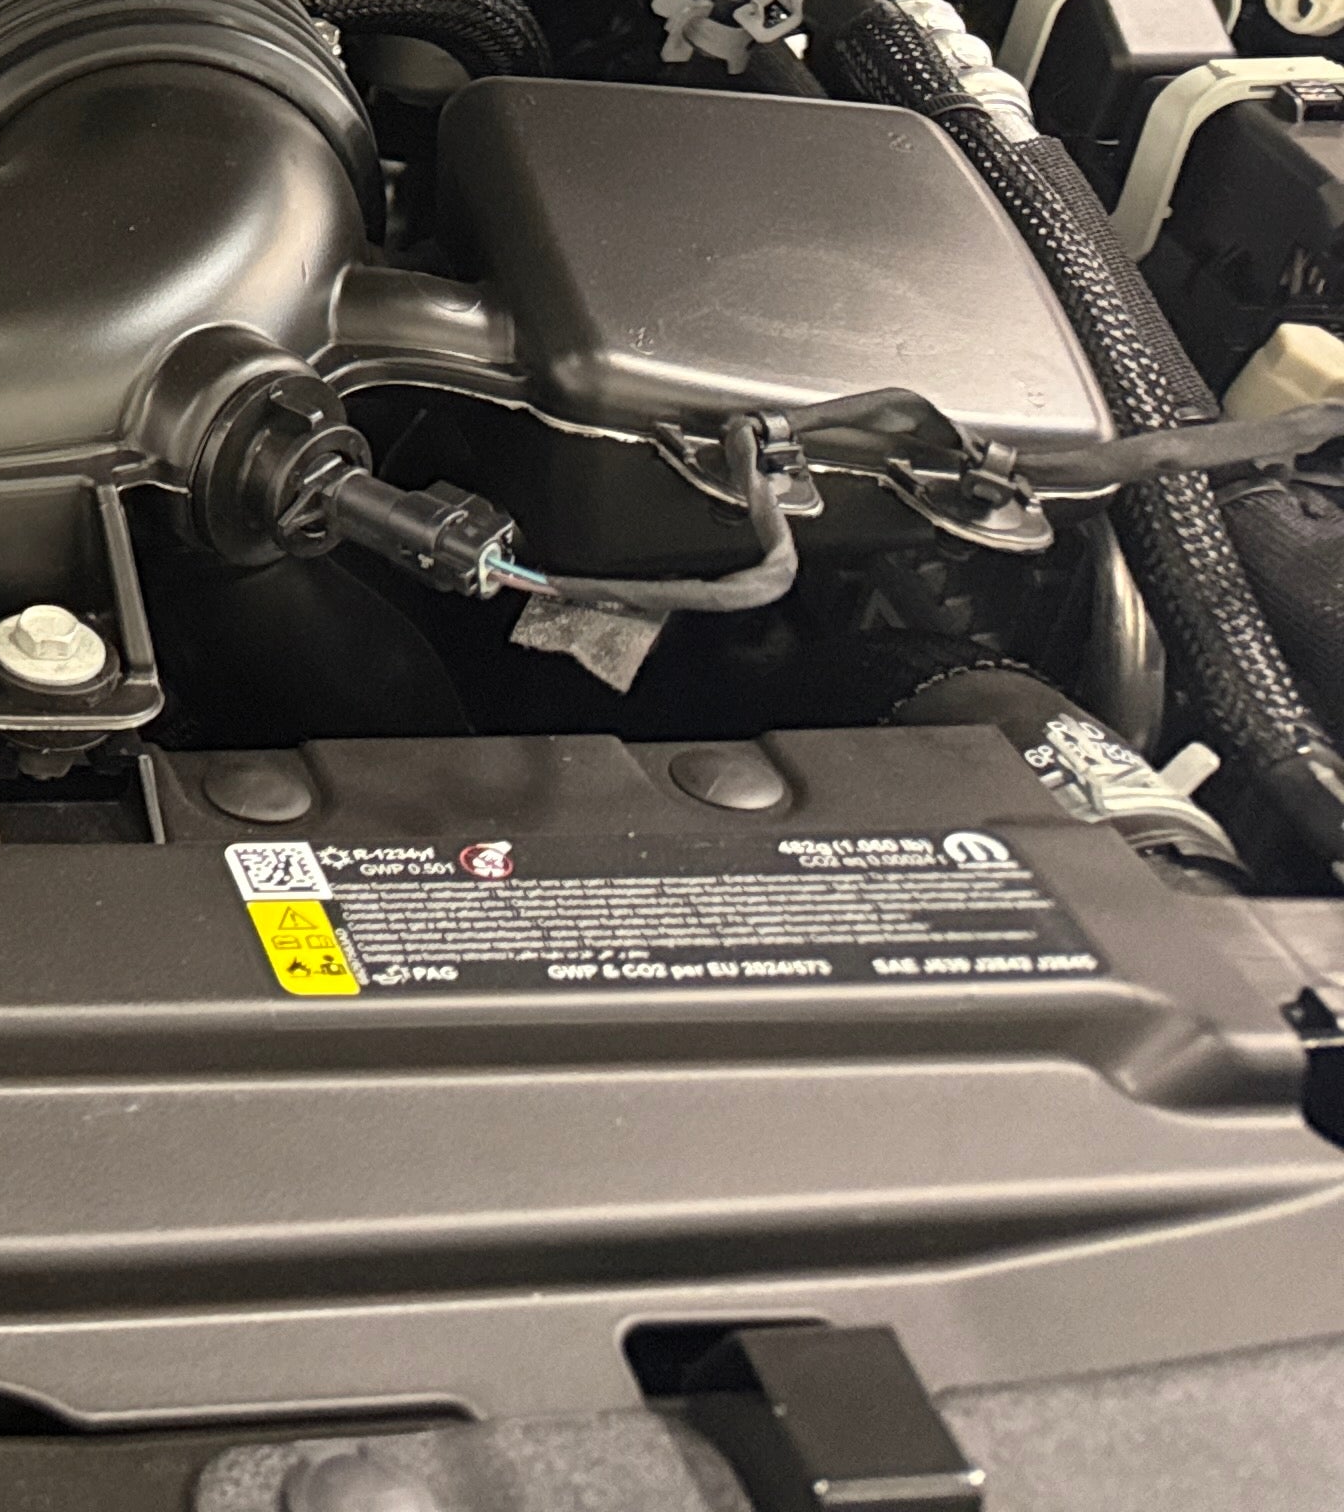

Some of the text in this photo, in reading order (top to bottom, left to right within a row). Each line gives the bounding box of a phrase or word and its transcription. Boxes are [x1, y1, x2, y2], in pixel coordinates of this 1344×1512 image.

[353, 846, 435, 862] R-1234yf
[359, 862, 456, 876] GWP 0.501
[413, 966, 459, 981] PAG
[547, 963, 598, 981] GWP
[621, 962, 668, 979] CO2
[669, 963, 704, 980] per
[705, 960, 740, 978] EU
